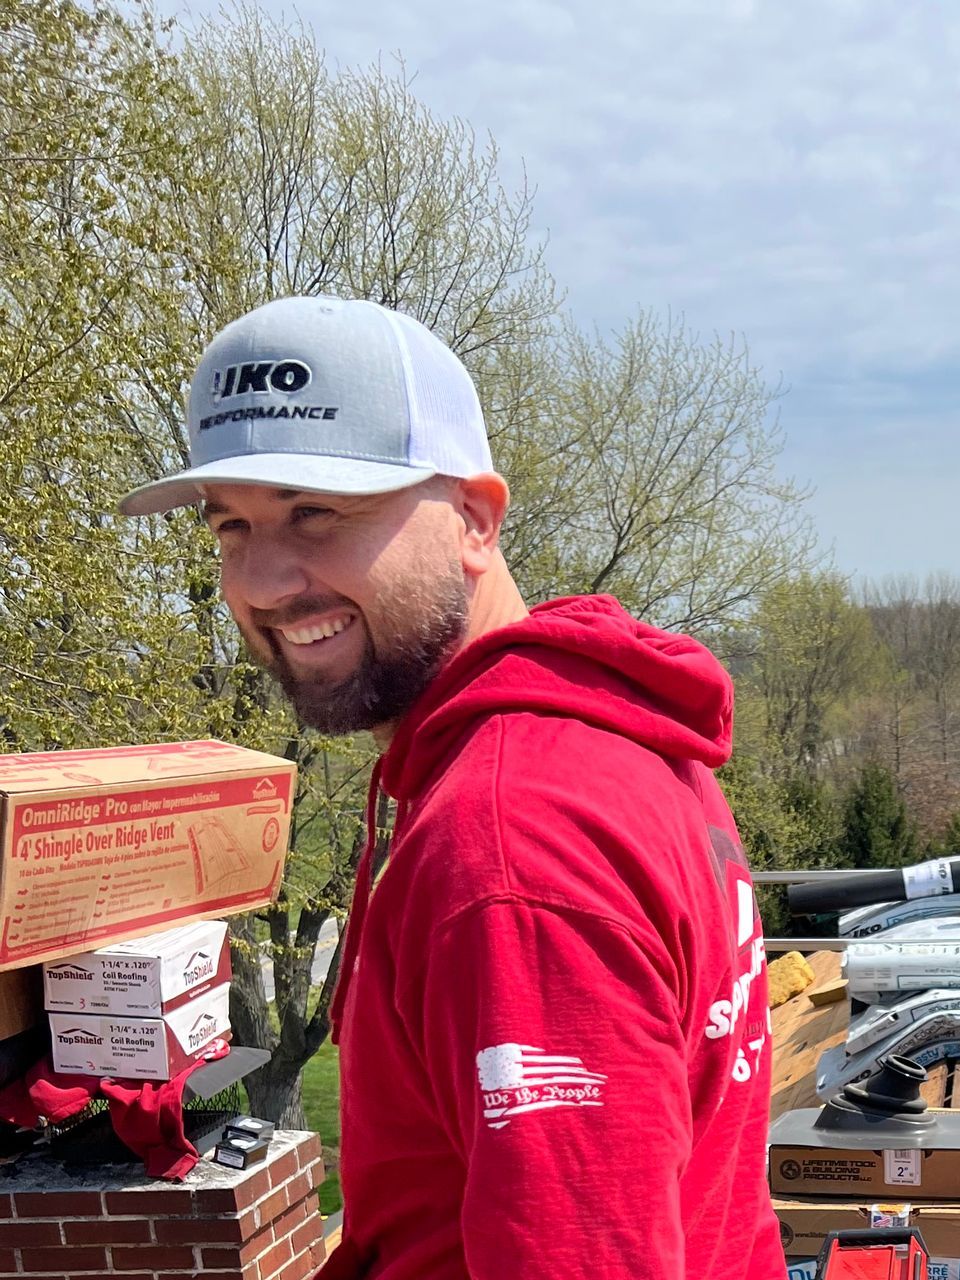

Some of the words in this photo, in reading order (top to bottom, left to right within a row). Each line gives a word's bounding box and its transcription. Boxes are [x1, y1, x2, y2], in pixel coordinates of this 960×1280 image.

[222, 360, 311, 398] IKO
[22, 803, 100, 827] OmniRidge
[106, 798, 127, 816] Pro
[34, 832, 83, 861] Shingle
[86, 831, 113, 852] Over
[116, 824, 147, 850] Ridge
[150, 820, 175, 841] Vent
[47, 970, 95, 981] TopShield
[102, 971, 116, 979] Coil
[117, 972, 147, 982] Roofing
[184, 960, 213, 986] TopShield
[57, 1035, 104, 1045] TopShield
[110, 1025, 131, 1033] 1-1/4"
[110, 1036, 124, 1044] Coil
[126, 1038, 155, 1047] Roofing
[483, 1090, 511, 1107] We
[542, 1085, 600, 1101] People
[851, 1160, 876, 1168] TOOL
[897, 1166, 908, 1177] 2"
[803, 1174, 859, 1182] PRODUCTS
